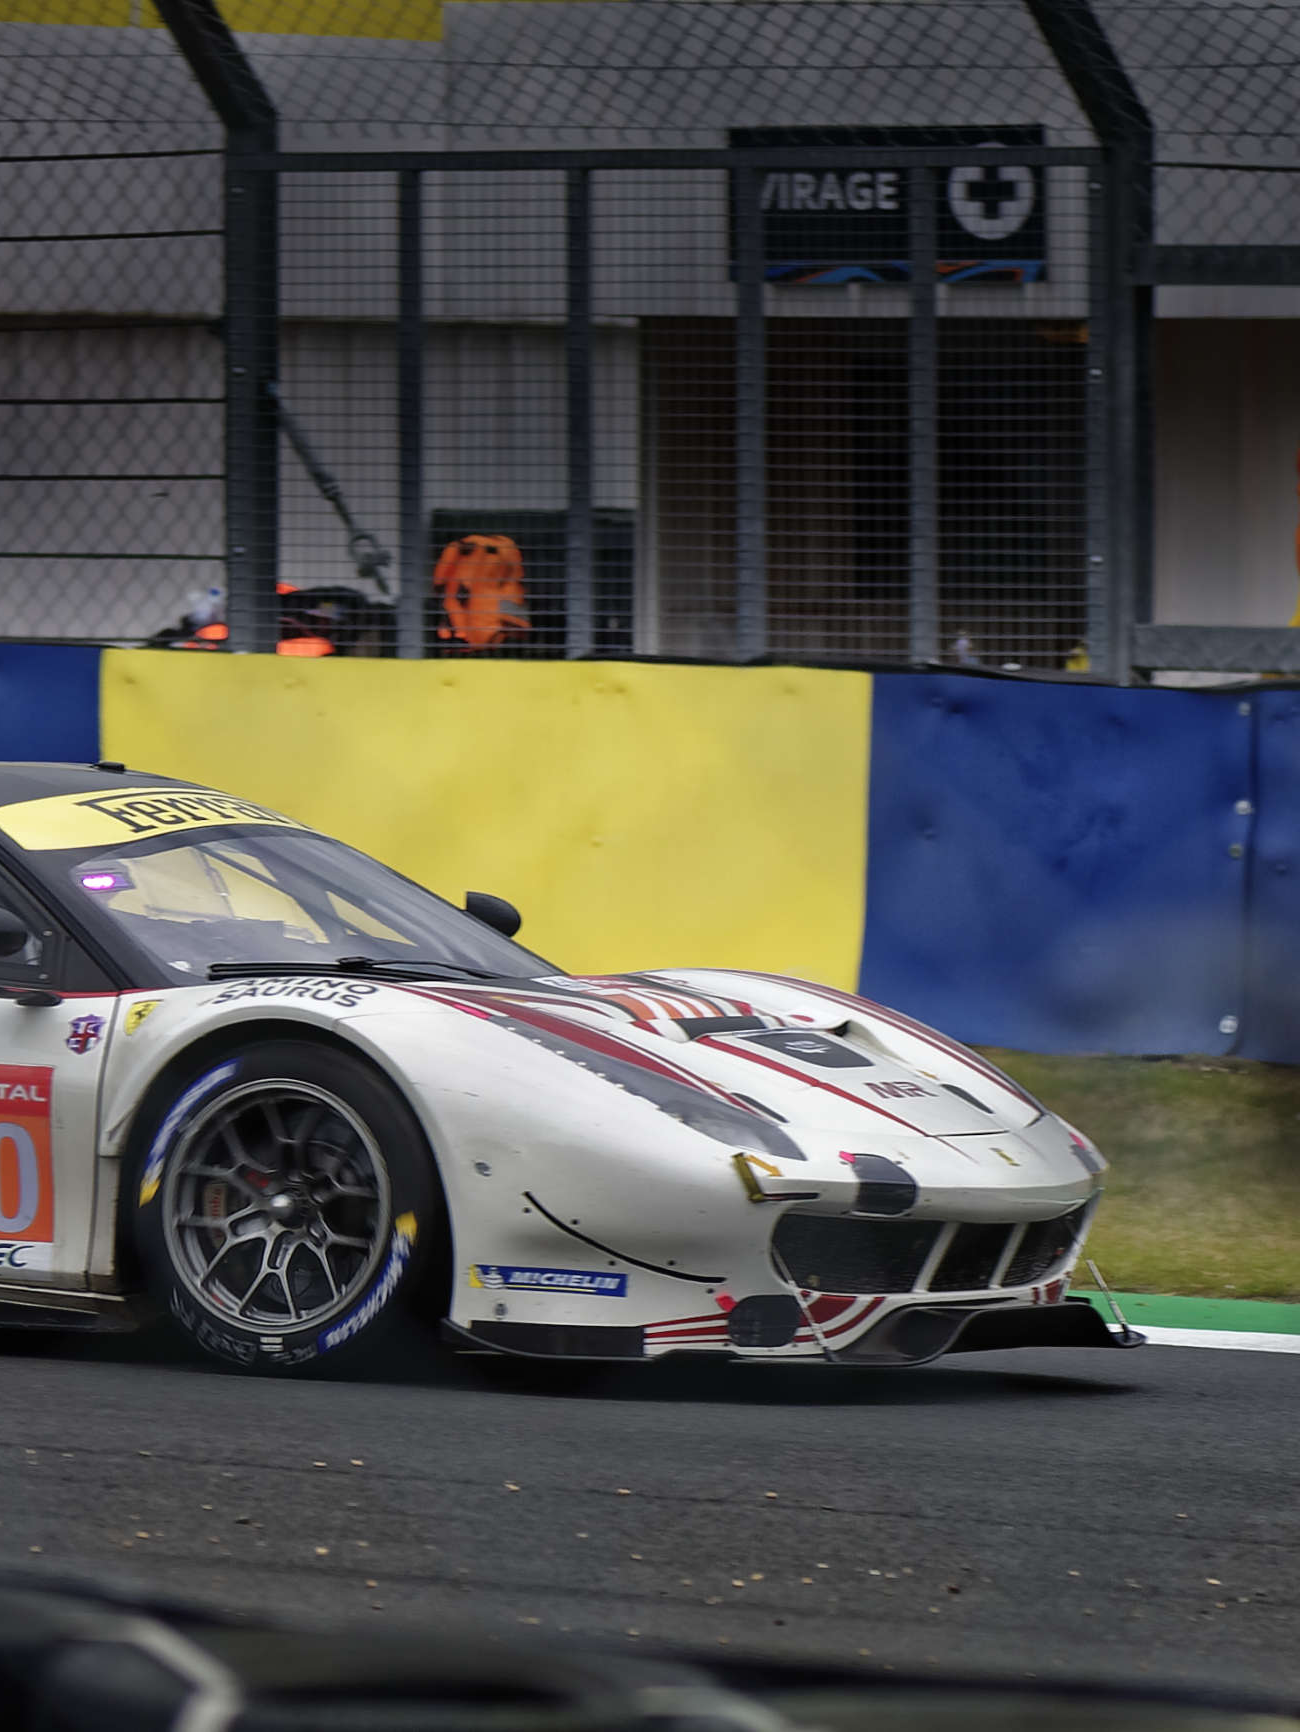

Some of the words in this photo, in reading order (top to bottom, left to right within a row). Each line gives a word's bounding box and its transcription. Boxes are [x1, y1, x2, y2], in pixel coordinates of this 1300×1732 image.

[225, 977, 379, 995] AMINO
[212, 985, 364, 1008] SAURUS
[508, 1271, 621, 1290] MICHELIN
